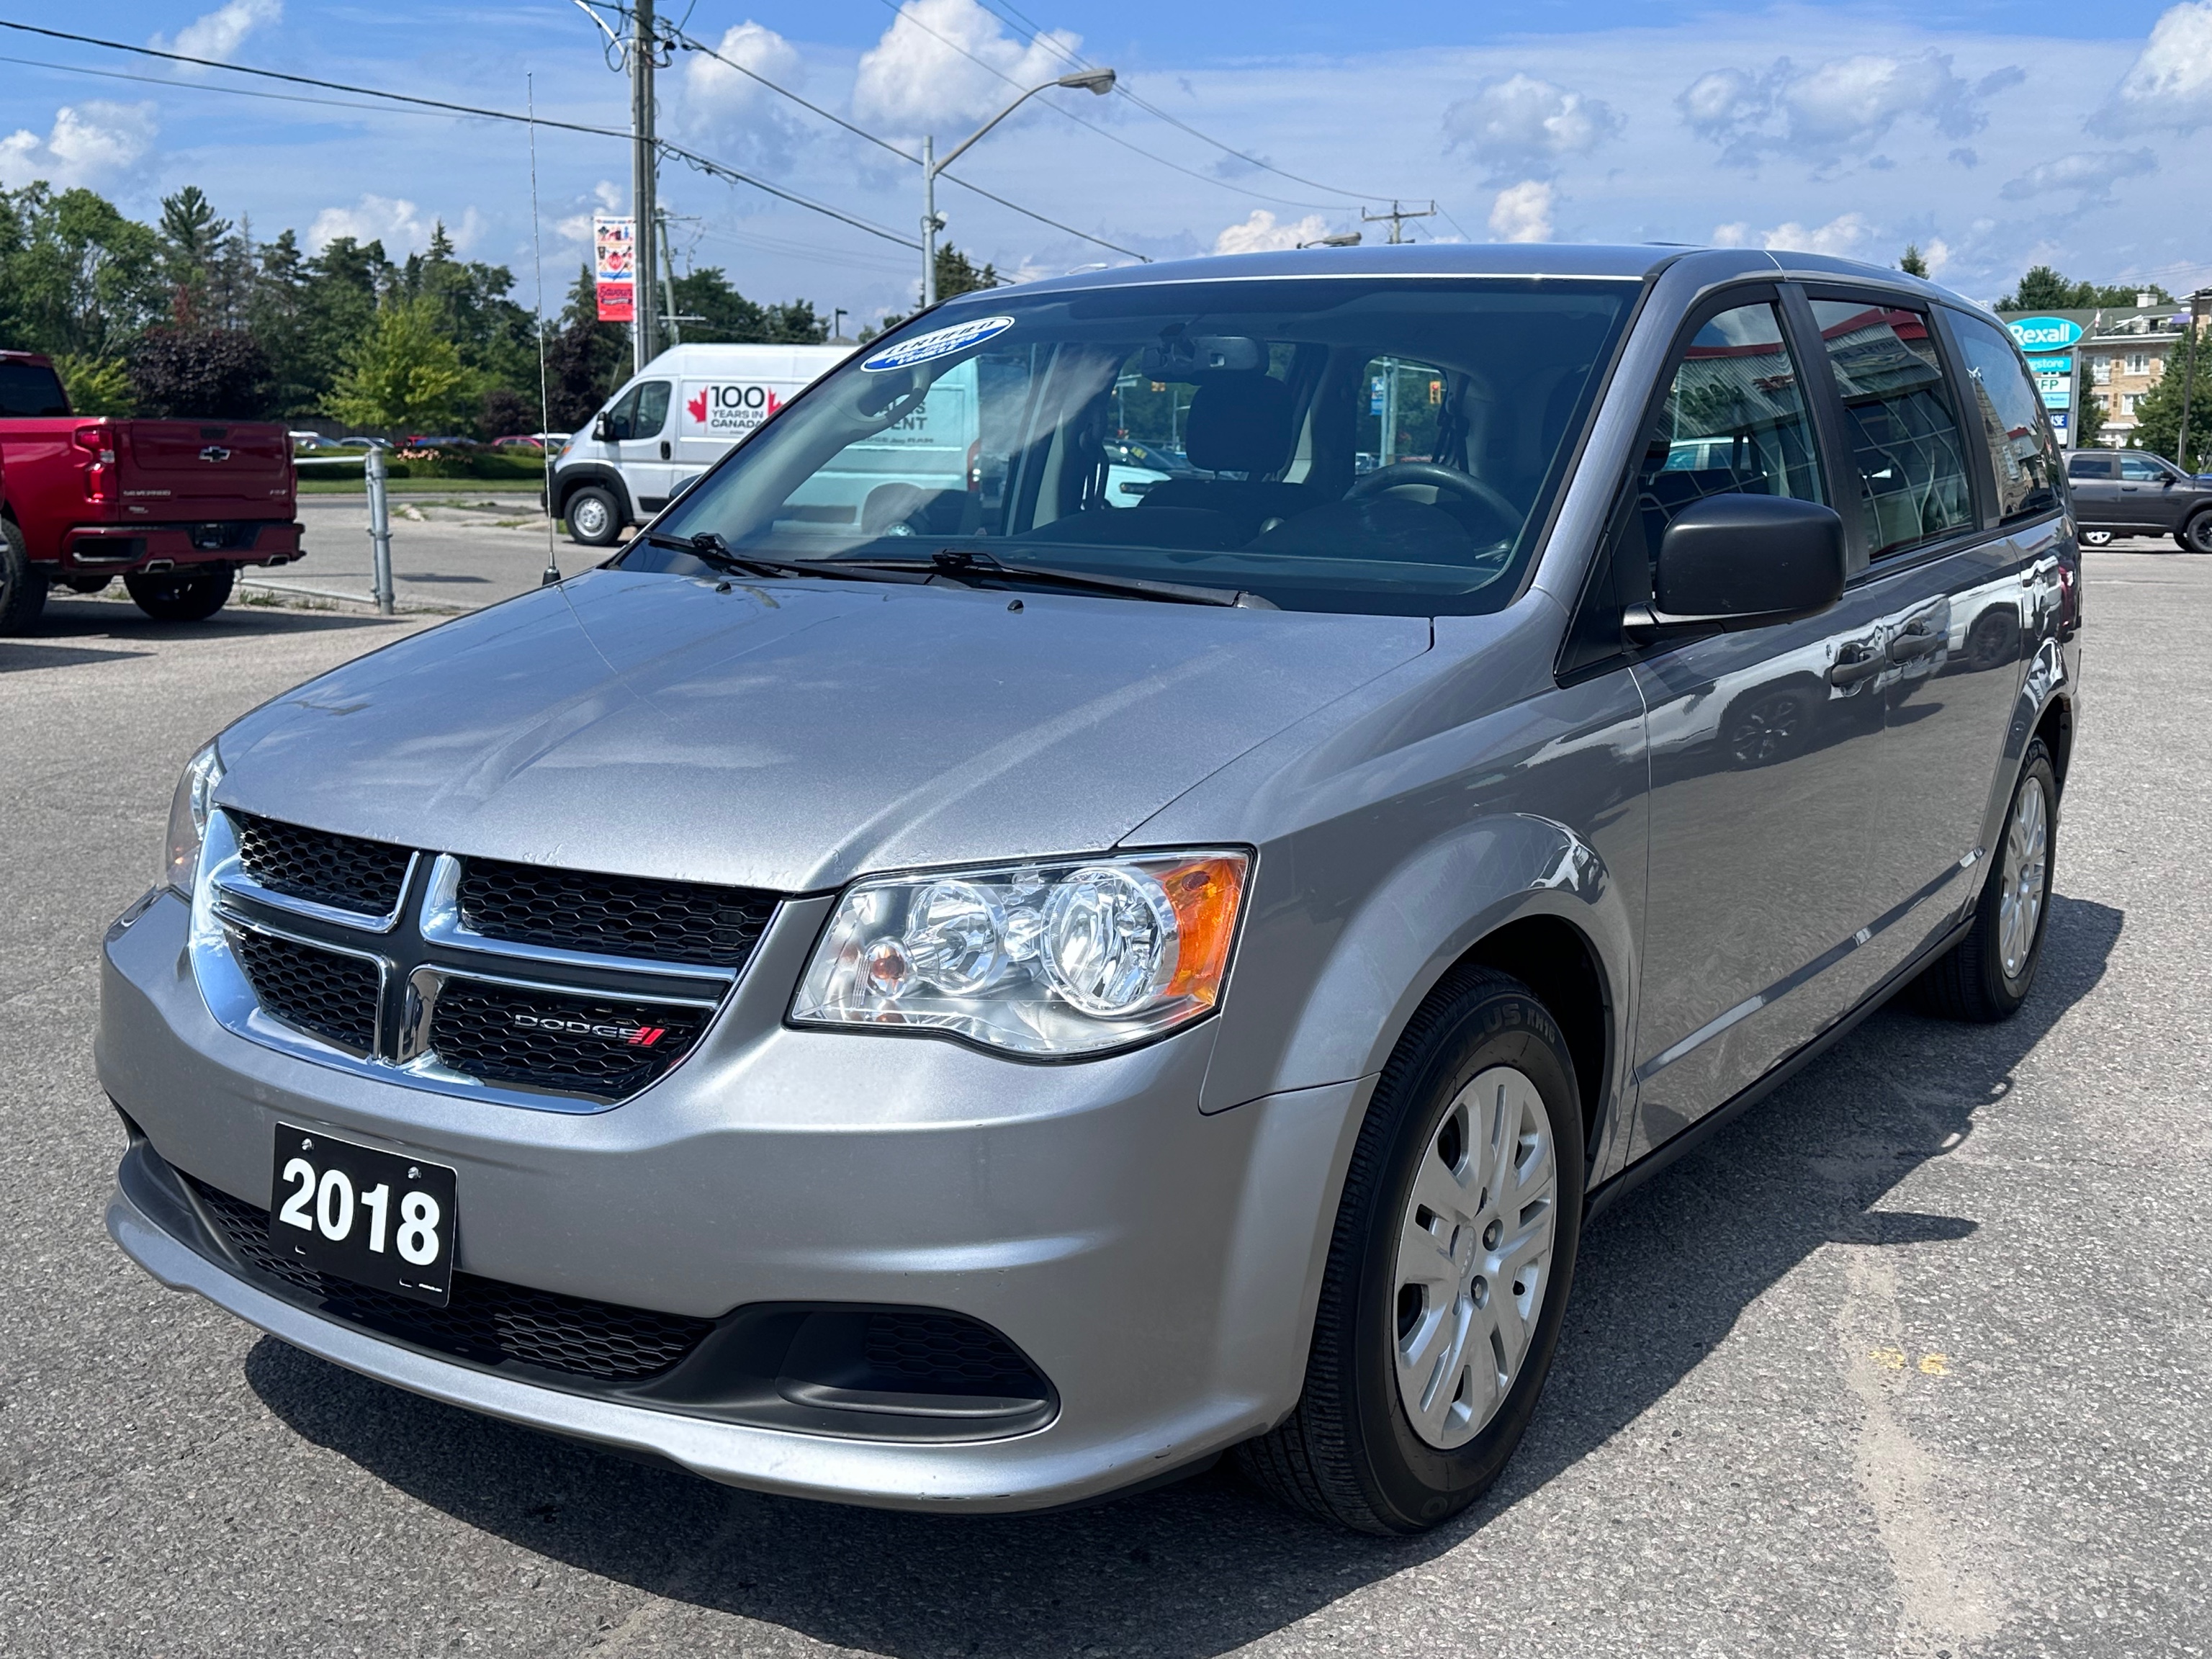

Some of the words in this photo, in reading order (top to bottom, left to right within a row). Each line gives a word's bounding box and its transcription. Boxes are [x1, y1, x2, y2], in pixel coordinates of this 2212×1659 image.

[2010, 323, 2070, 346] Rexall
[2028, 359, 2064, 371] gstore
[710, 386, 765, 408] 100
[712, 410, 750, 418] YEARS
[515, 1014, 644, 1041] DODGE
[279, 1158, 440, 1266] 2018
